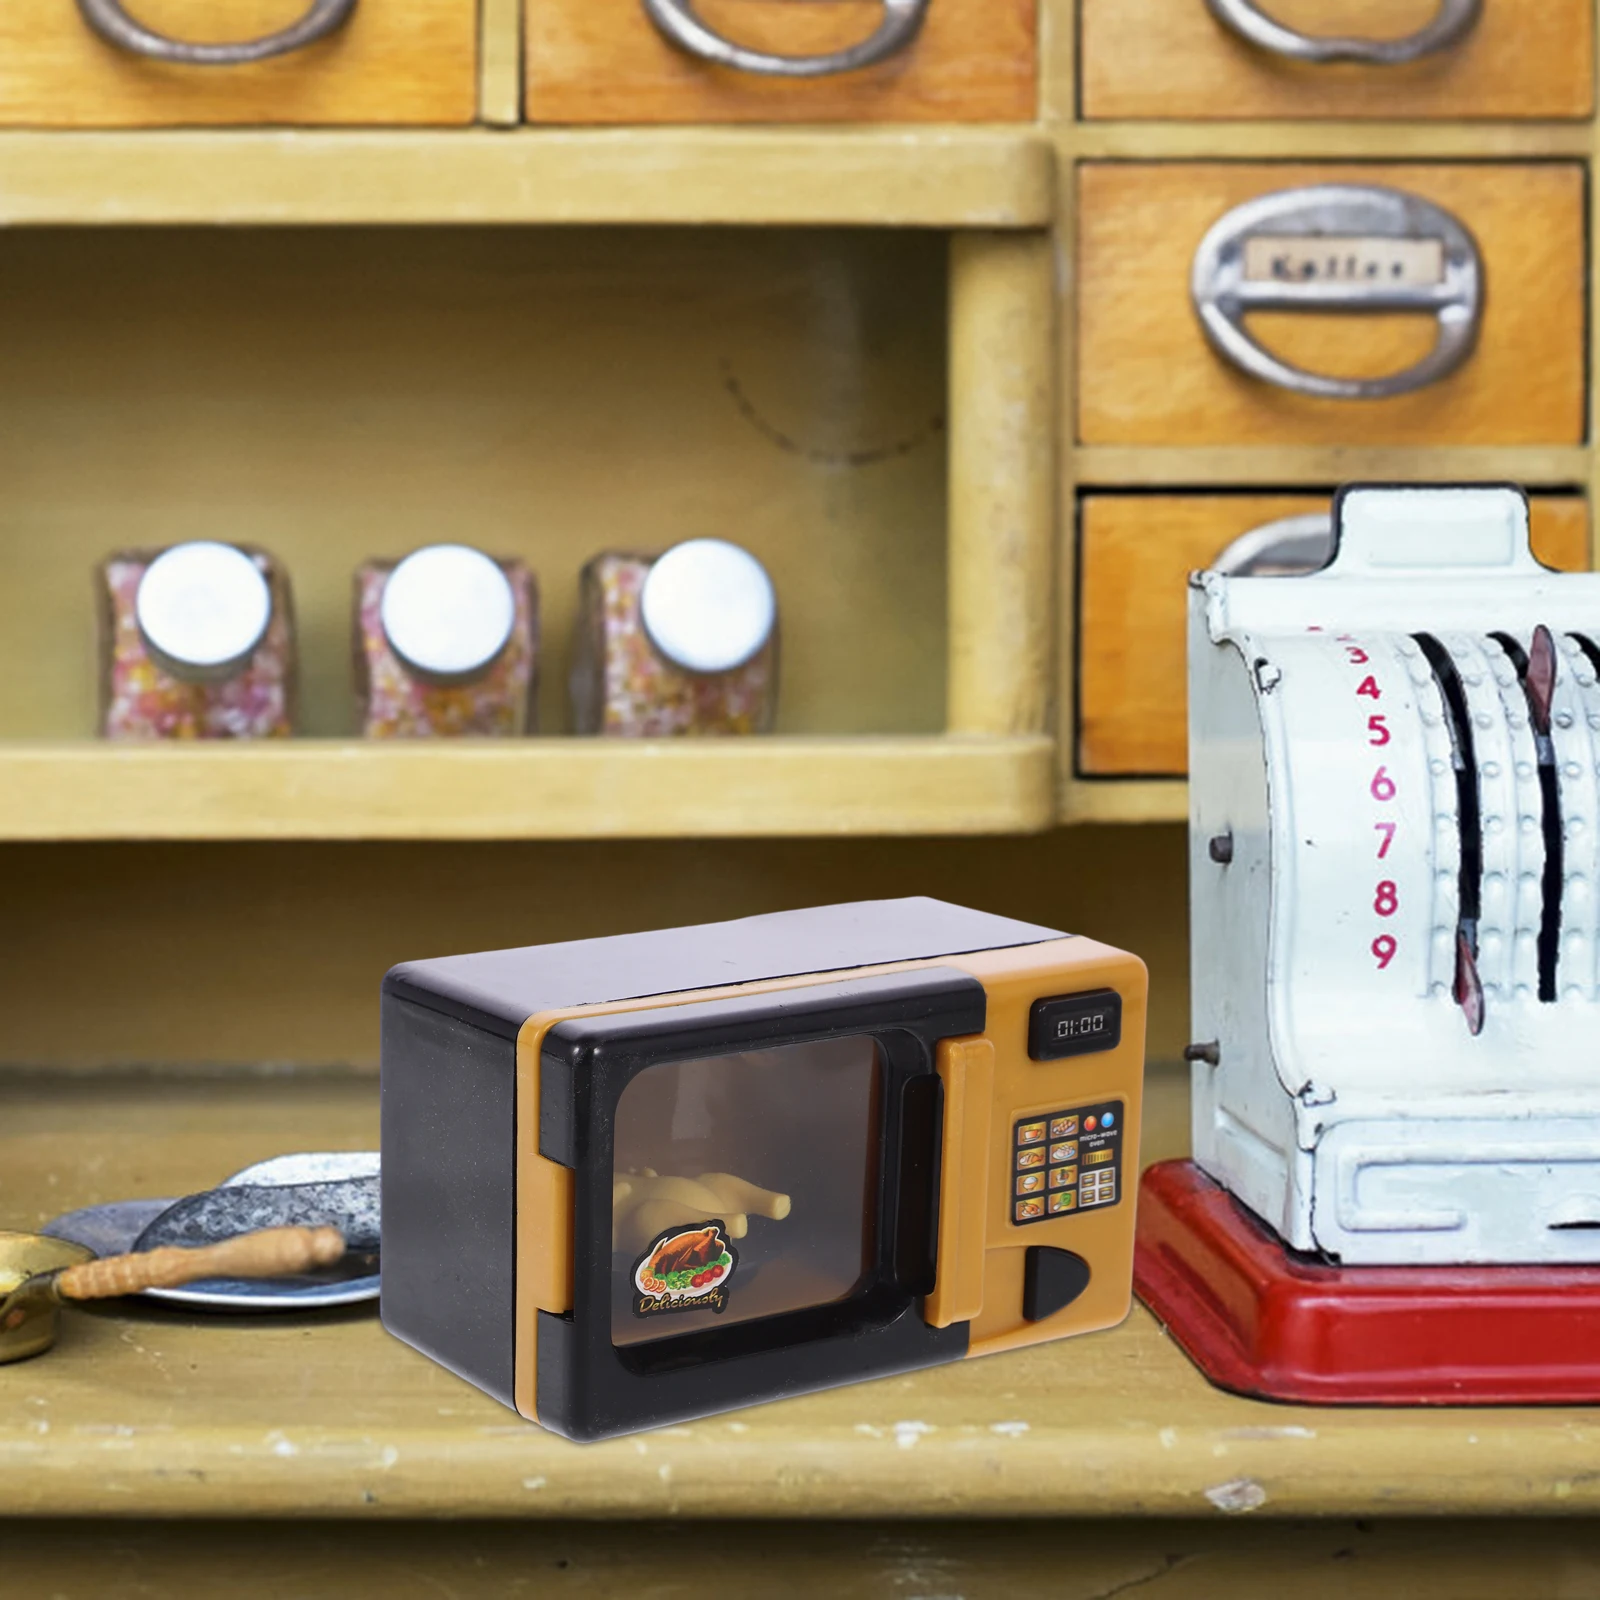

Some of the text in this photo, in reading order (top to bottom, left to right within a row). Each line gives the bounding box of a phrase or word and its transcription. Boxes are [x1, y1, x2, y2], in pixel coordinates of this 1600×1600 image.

[1346, 647, 1368, 664] 3
[1357, 676, 1381, 700] 4
[1368, 715, 1391, 746] 5
[1371, 766, 1396, 801] 6
[1375, 823, 1396, 858] 7
[1374, 881, 1398, 917] 8
[1371, 935, 1397, 970] 9
[1058, 1015, 1103, 1037] 01:00
[640, 1288, 723, 1312] Deliciously
